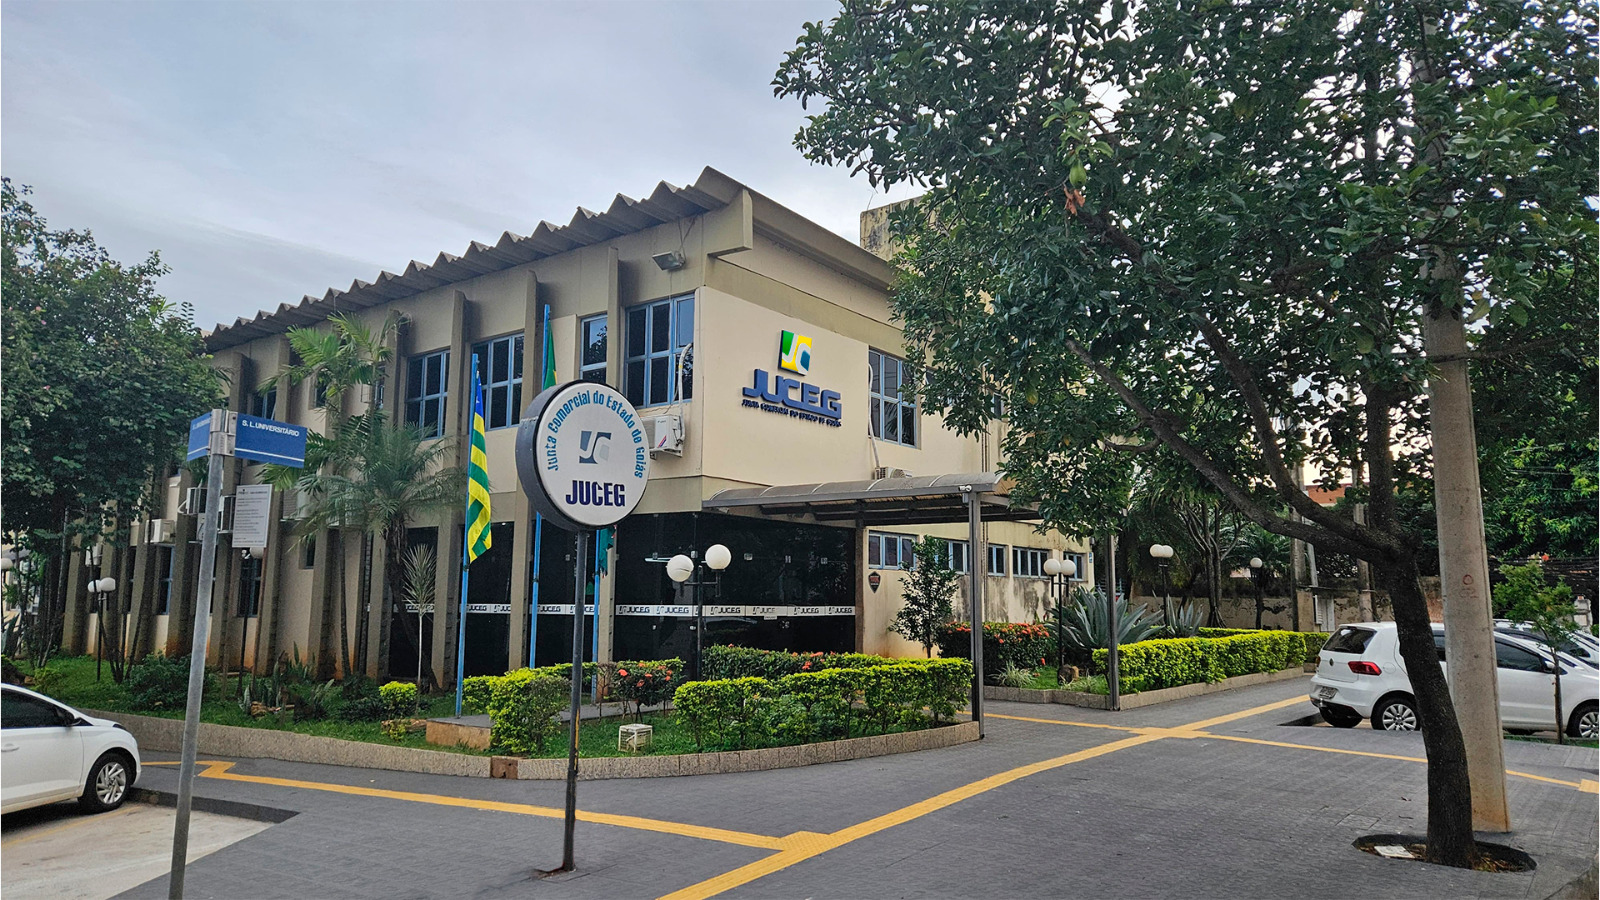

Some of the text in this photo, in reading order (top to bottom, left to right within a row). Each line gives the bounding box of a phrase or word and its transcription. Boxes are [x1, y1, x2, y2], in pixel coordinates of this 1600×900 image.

[742, 368, 842, 420] JUCEG
[545, 390, 647, 478] Junta Comercial do Estado de Goiás
[565, 480, 625, 507] JUCEG
